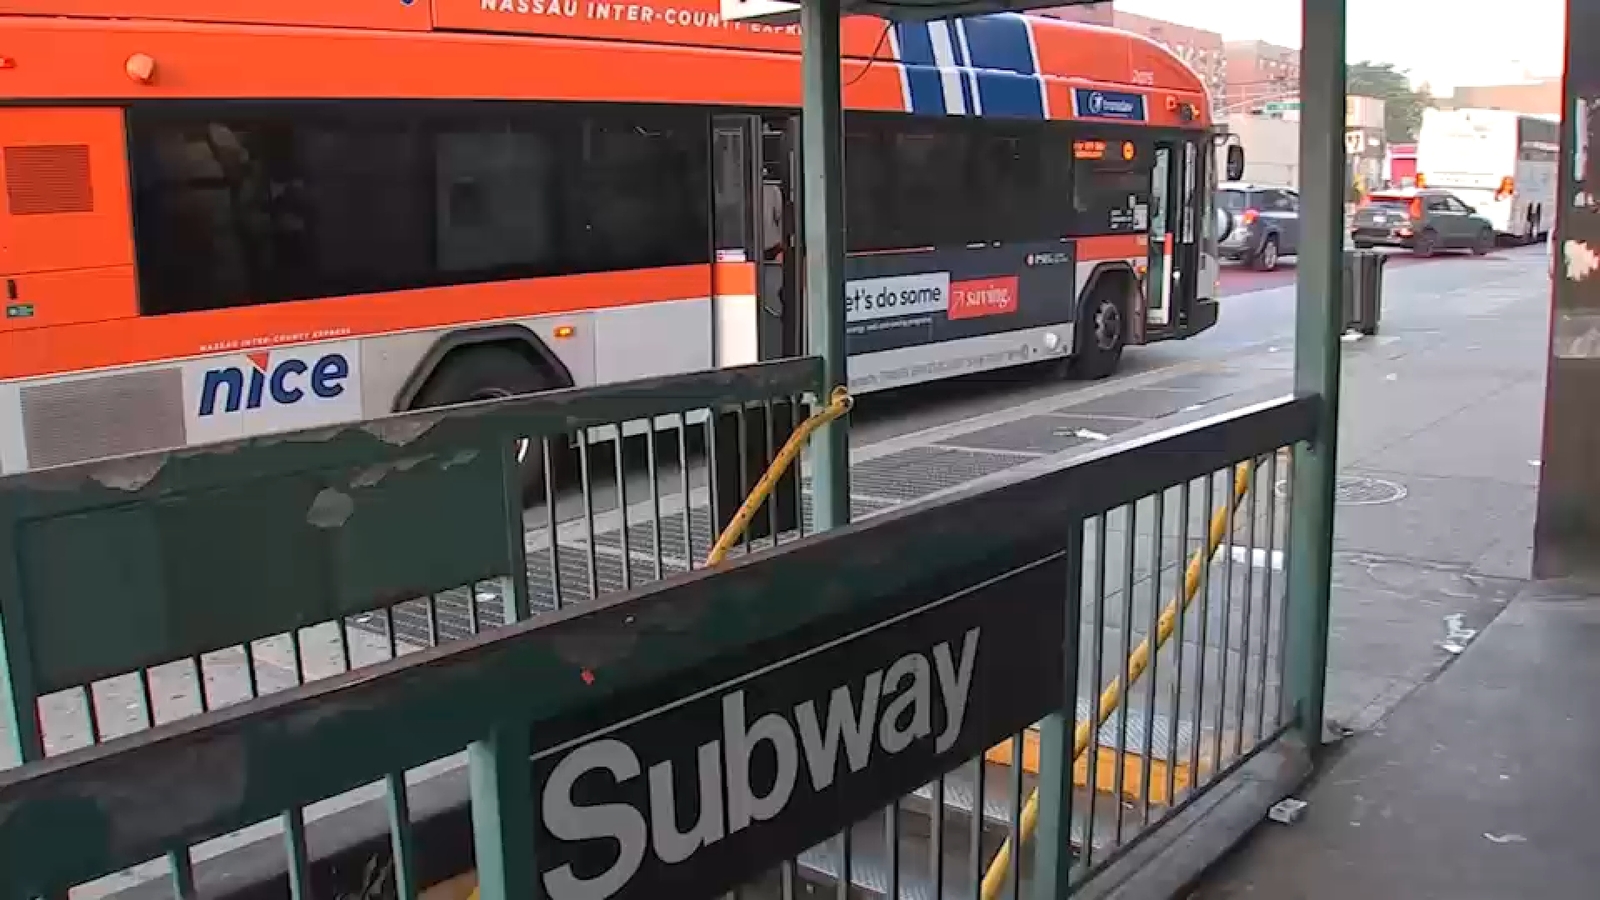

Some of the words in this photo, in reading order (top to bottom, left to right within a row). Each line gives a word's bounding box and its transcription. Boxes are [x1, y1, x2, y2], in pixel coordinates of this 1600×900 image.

[480, 0, 578, 16] NASSAU
[846, 285, 873, 313] et's
[876, 285, 898, 308] do
[900, 284, 941, 303] some
[198, 352, 349, 416] nice
[541, 626, 981, 900] Subway
